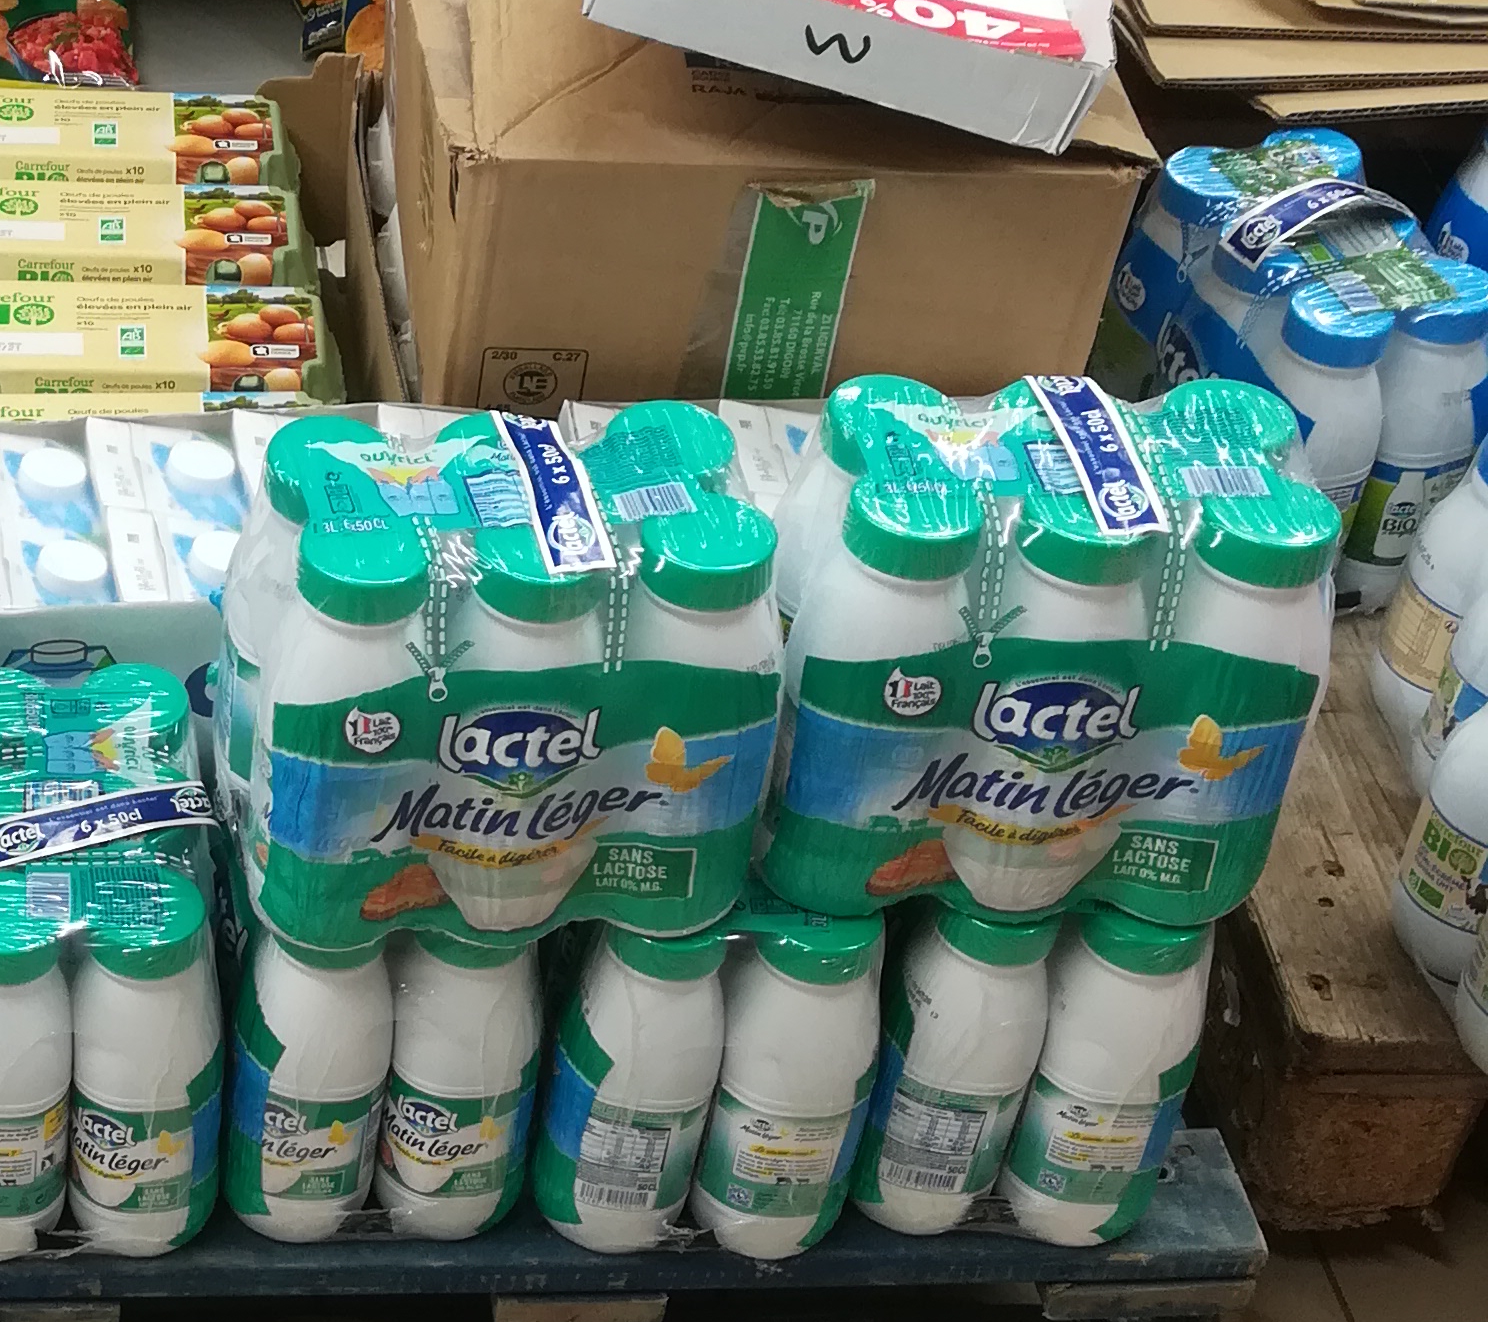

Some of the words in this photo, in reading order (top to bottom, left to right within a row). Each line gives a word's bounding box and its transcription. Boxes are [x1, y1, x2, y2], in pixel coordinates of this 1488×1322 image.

[15, 160, 70, 173] Carrefour
[125, 165, 145, 176] x10
[1241, 215, 1283, 249] lactel
[18, 259, 75, 271] Carrefour
[133, 263, 153, 274] x10
[76, 303, 124, 311] élevées
[144, 303, 174, 311] plein
[34, 377, 94, 387] Carrefour
[155, 380, 176, 389] x10
[912, 680, 935, 691] Lait
[891, 696, 937, 710] Français
[971, 682, 1143, 744] lactel
[353, 734, 396, 748] Français
[438, 707, 605, 775] lactel
[892, 753, 1044, 813] Matin
[1054, 764, 1201, 818] léger
[80, 822, 92, 833] 6
[94, 818, 106, 828] x
[107, 808, 143, 826] 50cl
[371, 781, 520, 844] Matin
[532, 785, 669, 842] léger
[956, 808, 1004, 833] Facile
[436, 838, 484, 864] Facile
[1130, 833, 1180, 854] SANS
[608, 847, 654, 865] SANS
[1113, 849, 1192, 873] LACTOSE
[593, 860, 669, 880] LACTOSE
[1113, 864, 1140, 878] LAIT
[595, 877, 622, 891] LAIT
[397, 1093, 459, 1134] lactel
[78, 1107, 136, 1147] lactel
[382, 1107, 425, 1151] Matin
[428, 1139, 484, 1159] léger
[278, 1141, 336, 1163] léger
[109, 1155, 166, 1175] léger
